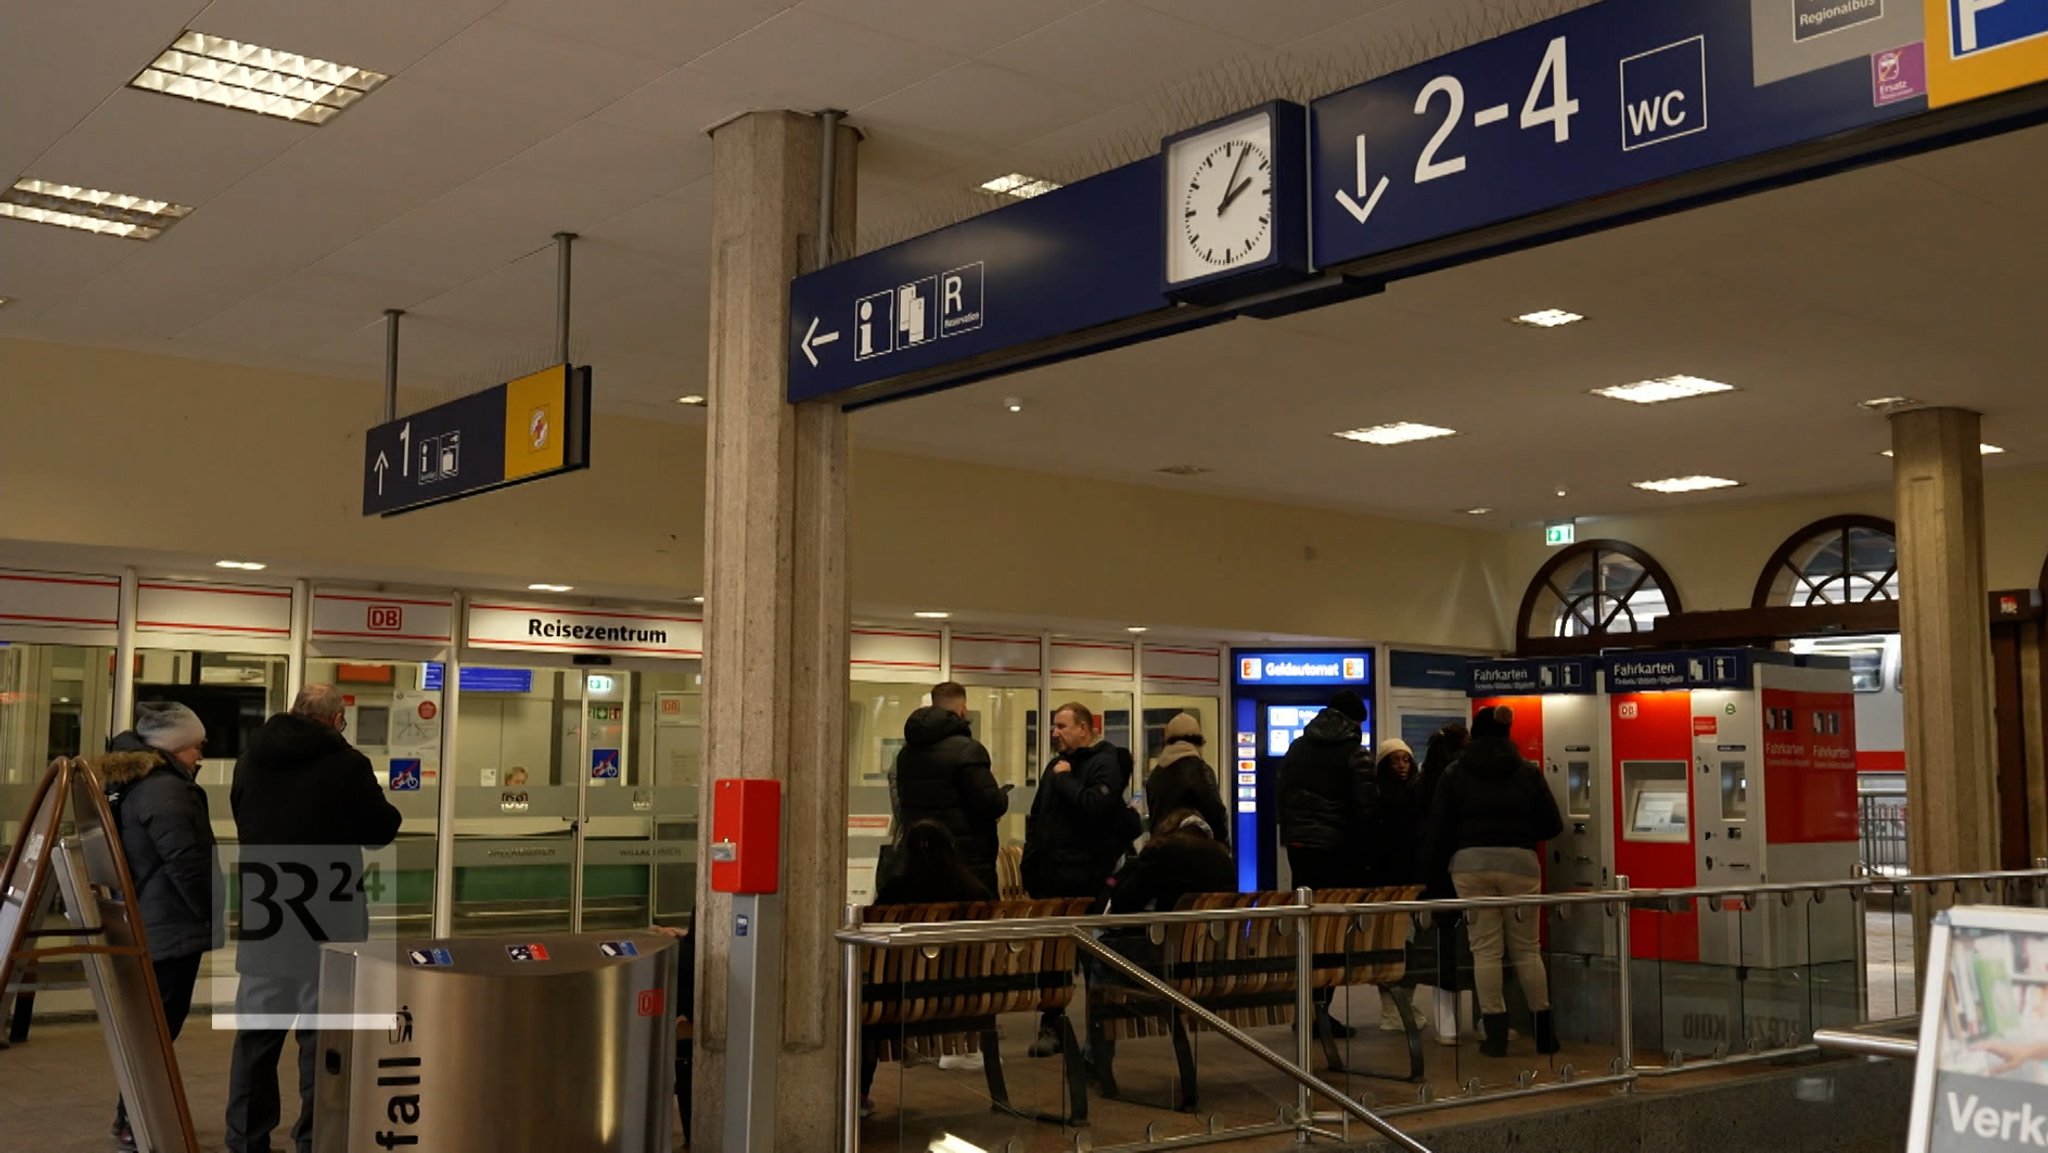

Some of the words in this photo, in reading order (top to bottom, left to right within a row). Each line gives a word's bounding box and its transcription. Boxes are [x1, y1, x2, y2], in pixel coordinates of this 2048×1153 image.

[1413, 36, 1579, 184] 2-4
[1628, 90, 1687, 136] WC
[945, 275, 962, 315] R
[400, 420, 411, 477] 1
[371, 608, 398, 627] DB
[528, 618, 667, 644] Reisezentrum
[1474, 669, 1528, 681] Fahrkarten
[1613, 662, 1675, 676] Fahrkarten
[1621, 705, 1635, 716] DB
[1947, 1091, 2048, 1151] Verk
